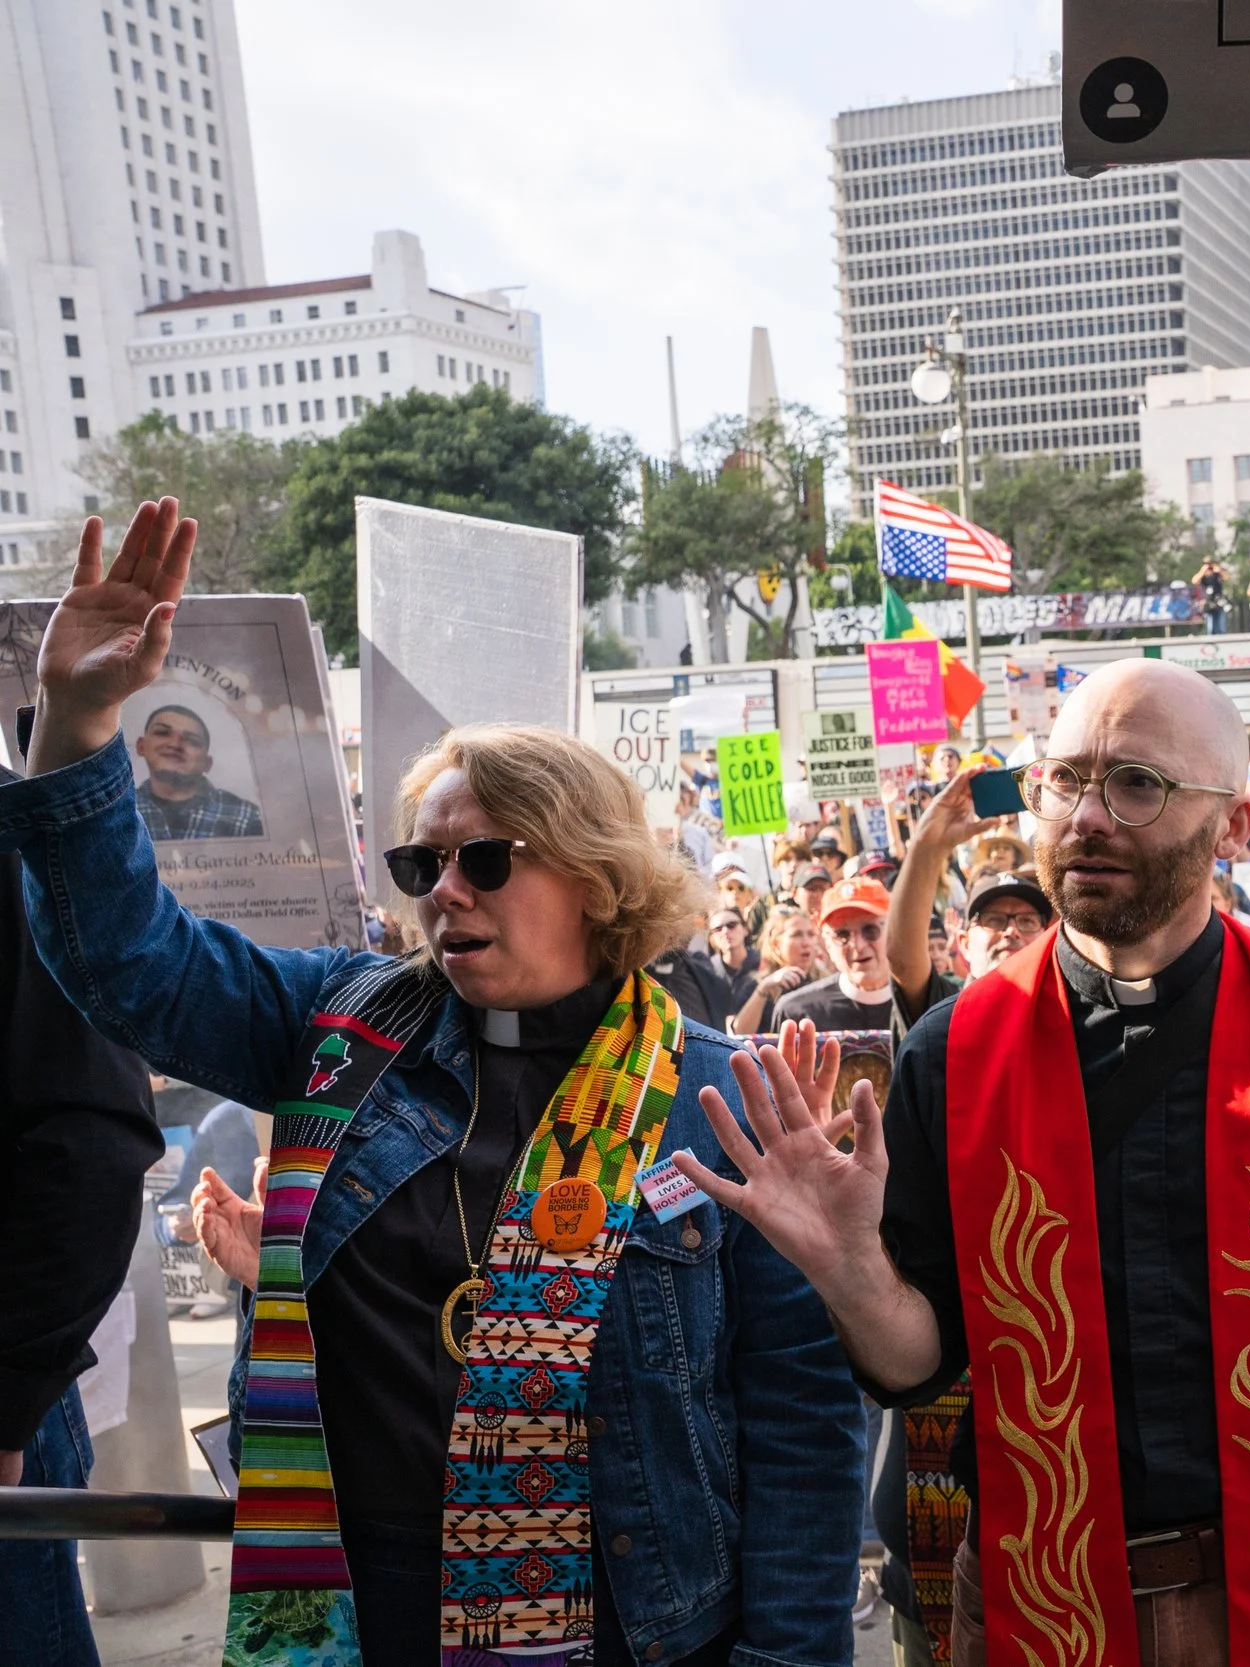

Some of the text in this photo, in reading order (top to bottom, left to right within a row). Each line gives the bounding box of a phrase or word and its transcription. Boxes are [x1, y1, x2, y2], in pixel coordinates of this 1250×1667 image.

[164, 654, 246, 701] TENTION
[619, 708, 671, 735] ICE
[613, 737, 670, 763] OUT
[727, 738, 769, 757] ICE
[808, 735, 874, 753] JUSTICE FOR
[629, 764, 677, 792] OW
[728, 759, 775, 783] COLD
[728, 780, 786, 826] KILLER
[157, 849, 190, 876] ngel
[641, 1160, 674, 1182] AFFIRM
[653, 1168, 684, 1187] TRAN
[550, 1183, 591, 1198] LOVE
[653, 1194, 679, 1212] HOLY
[678, 1185, 700, 1199] WO
[657, 1179, 683, 1197] LIVES
[547, 1203, 590, 1212] BORDERS
[549, 1196, 590, 1205] KNOWS NO
